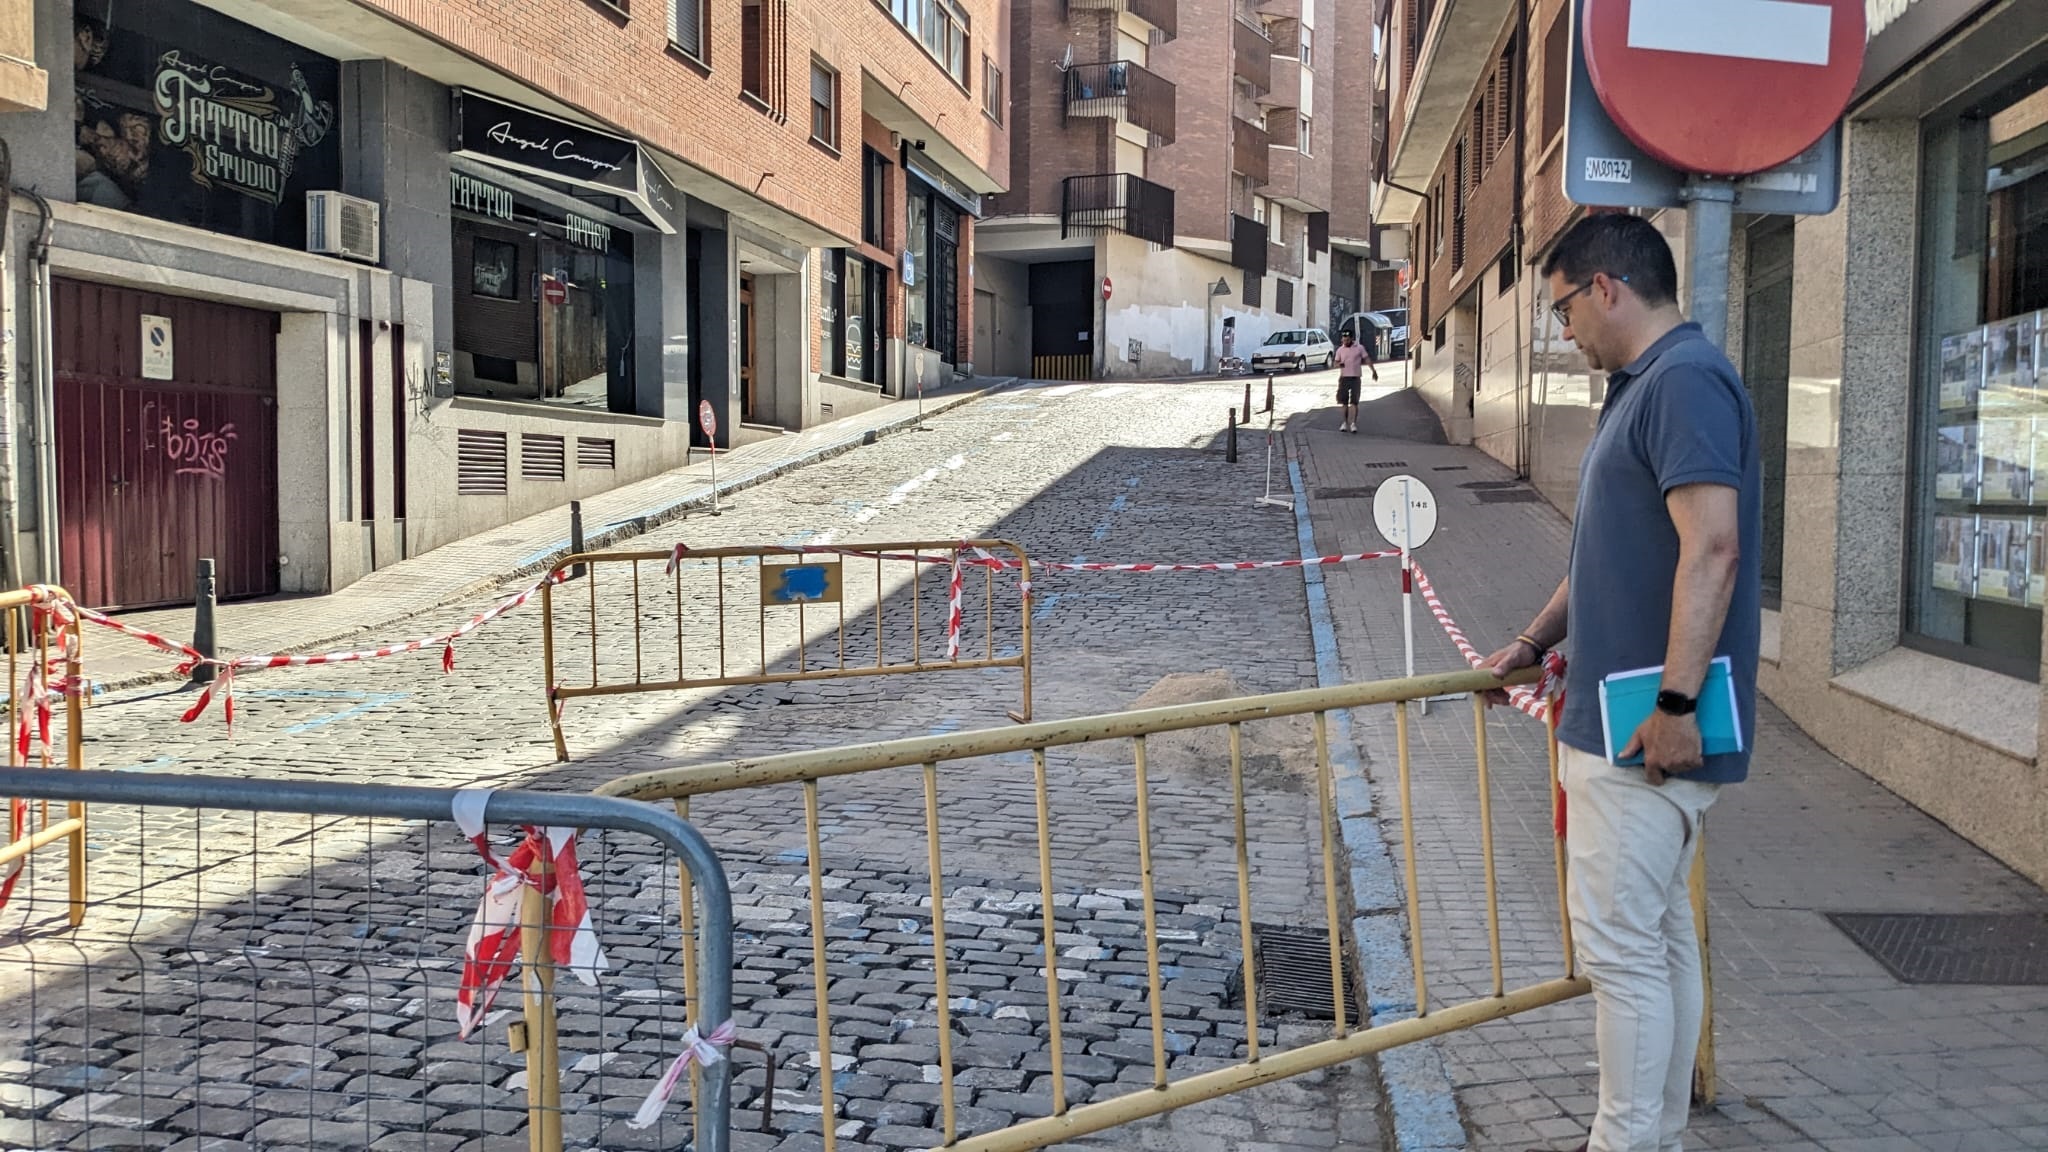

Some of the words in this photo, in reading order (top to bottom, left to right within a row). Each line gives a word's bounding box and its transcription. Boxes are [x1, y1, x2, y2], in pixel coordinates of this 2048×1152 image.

[486, 121, 549, 151] Angel
[450, 172, 514, 222] TATTOO
[566, 213, 611, 254] ARTIST
